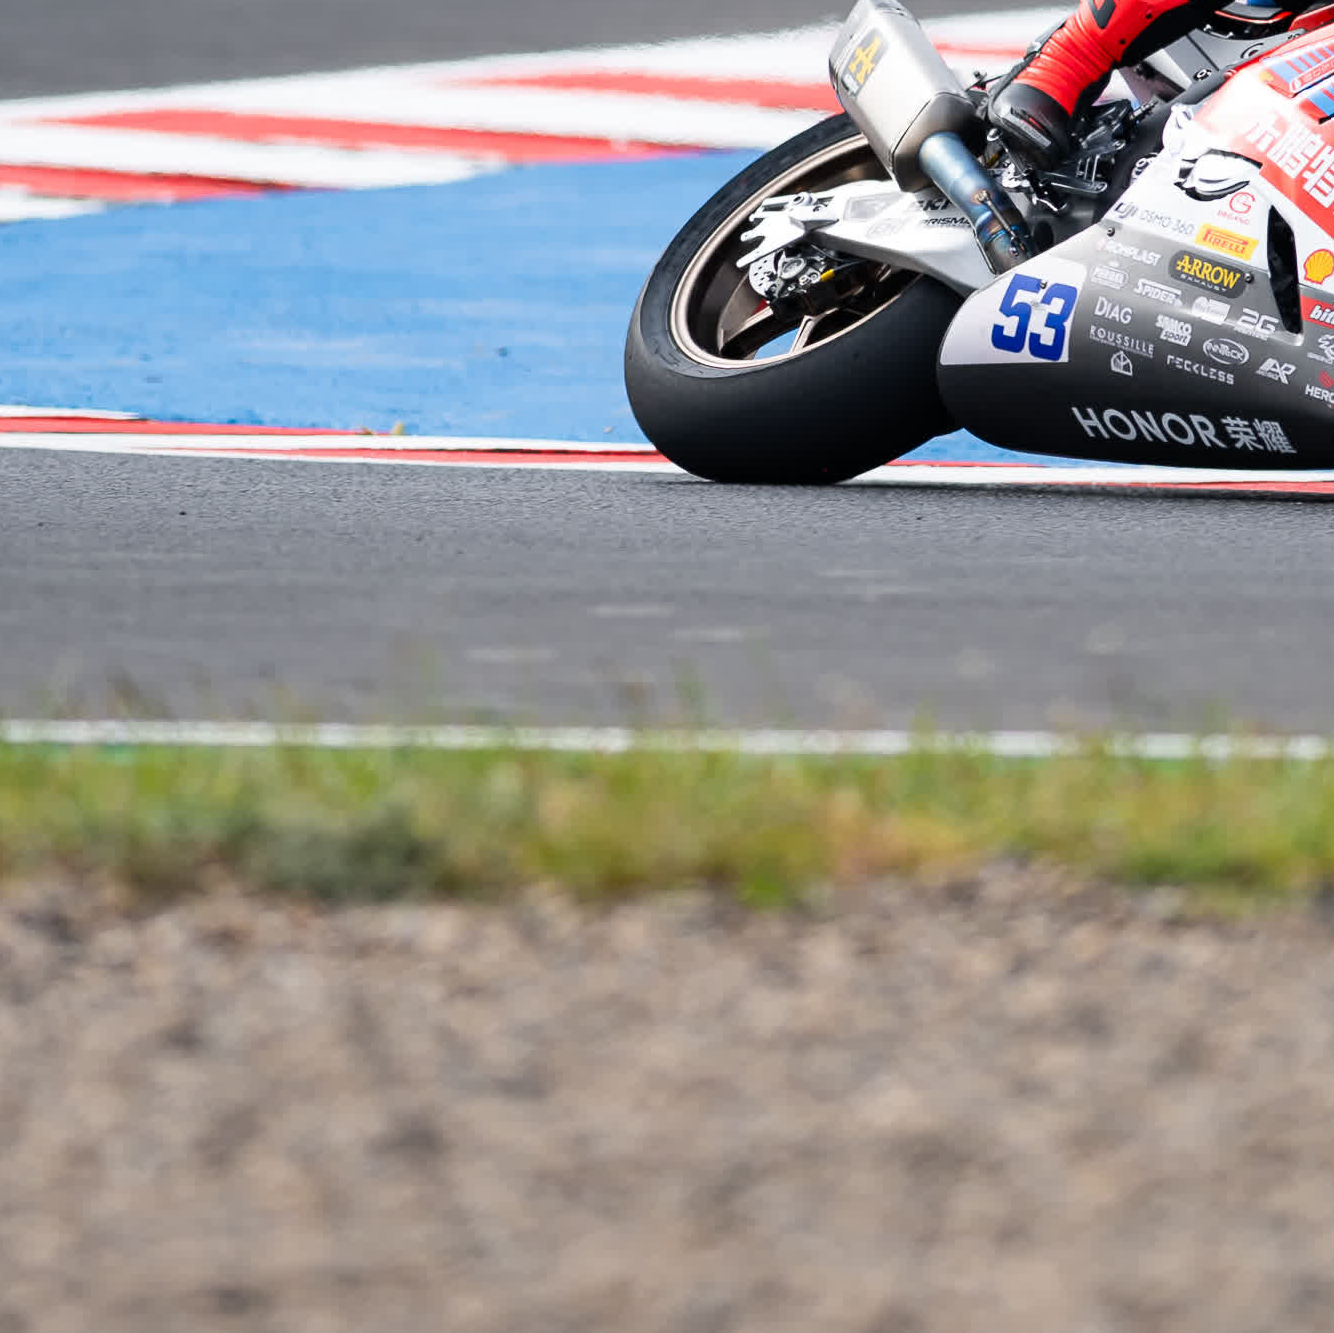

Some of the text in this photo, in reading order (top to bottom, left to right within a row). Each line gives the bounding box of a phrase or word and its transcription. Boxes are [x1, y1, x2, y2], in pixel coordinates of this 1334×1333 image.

[1203, 228, 1248, 254] PIRELLI
[1176, 254, 1241, 289] ARROW
[1180, 274, 1227, 293] EXHAUST
[1134, 278, 1182, 306] SPIDER
[991, 273, 1078, 362] 53
[1094, 296, 1133, 324] DIAG
[1090, 325, 1155, 355] ROUSSILLE
[1071, 406, 1297, 455] HONOR 荣耀
